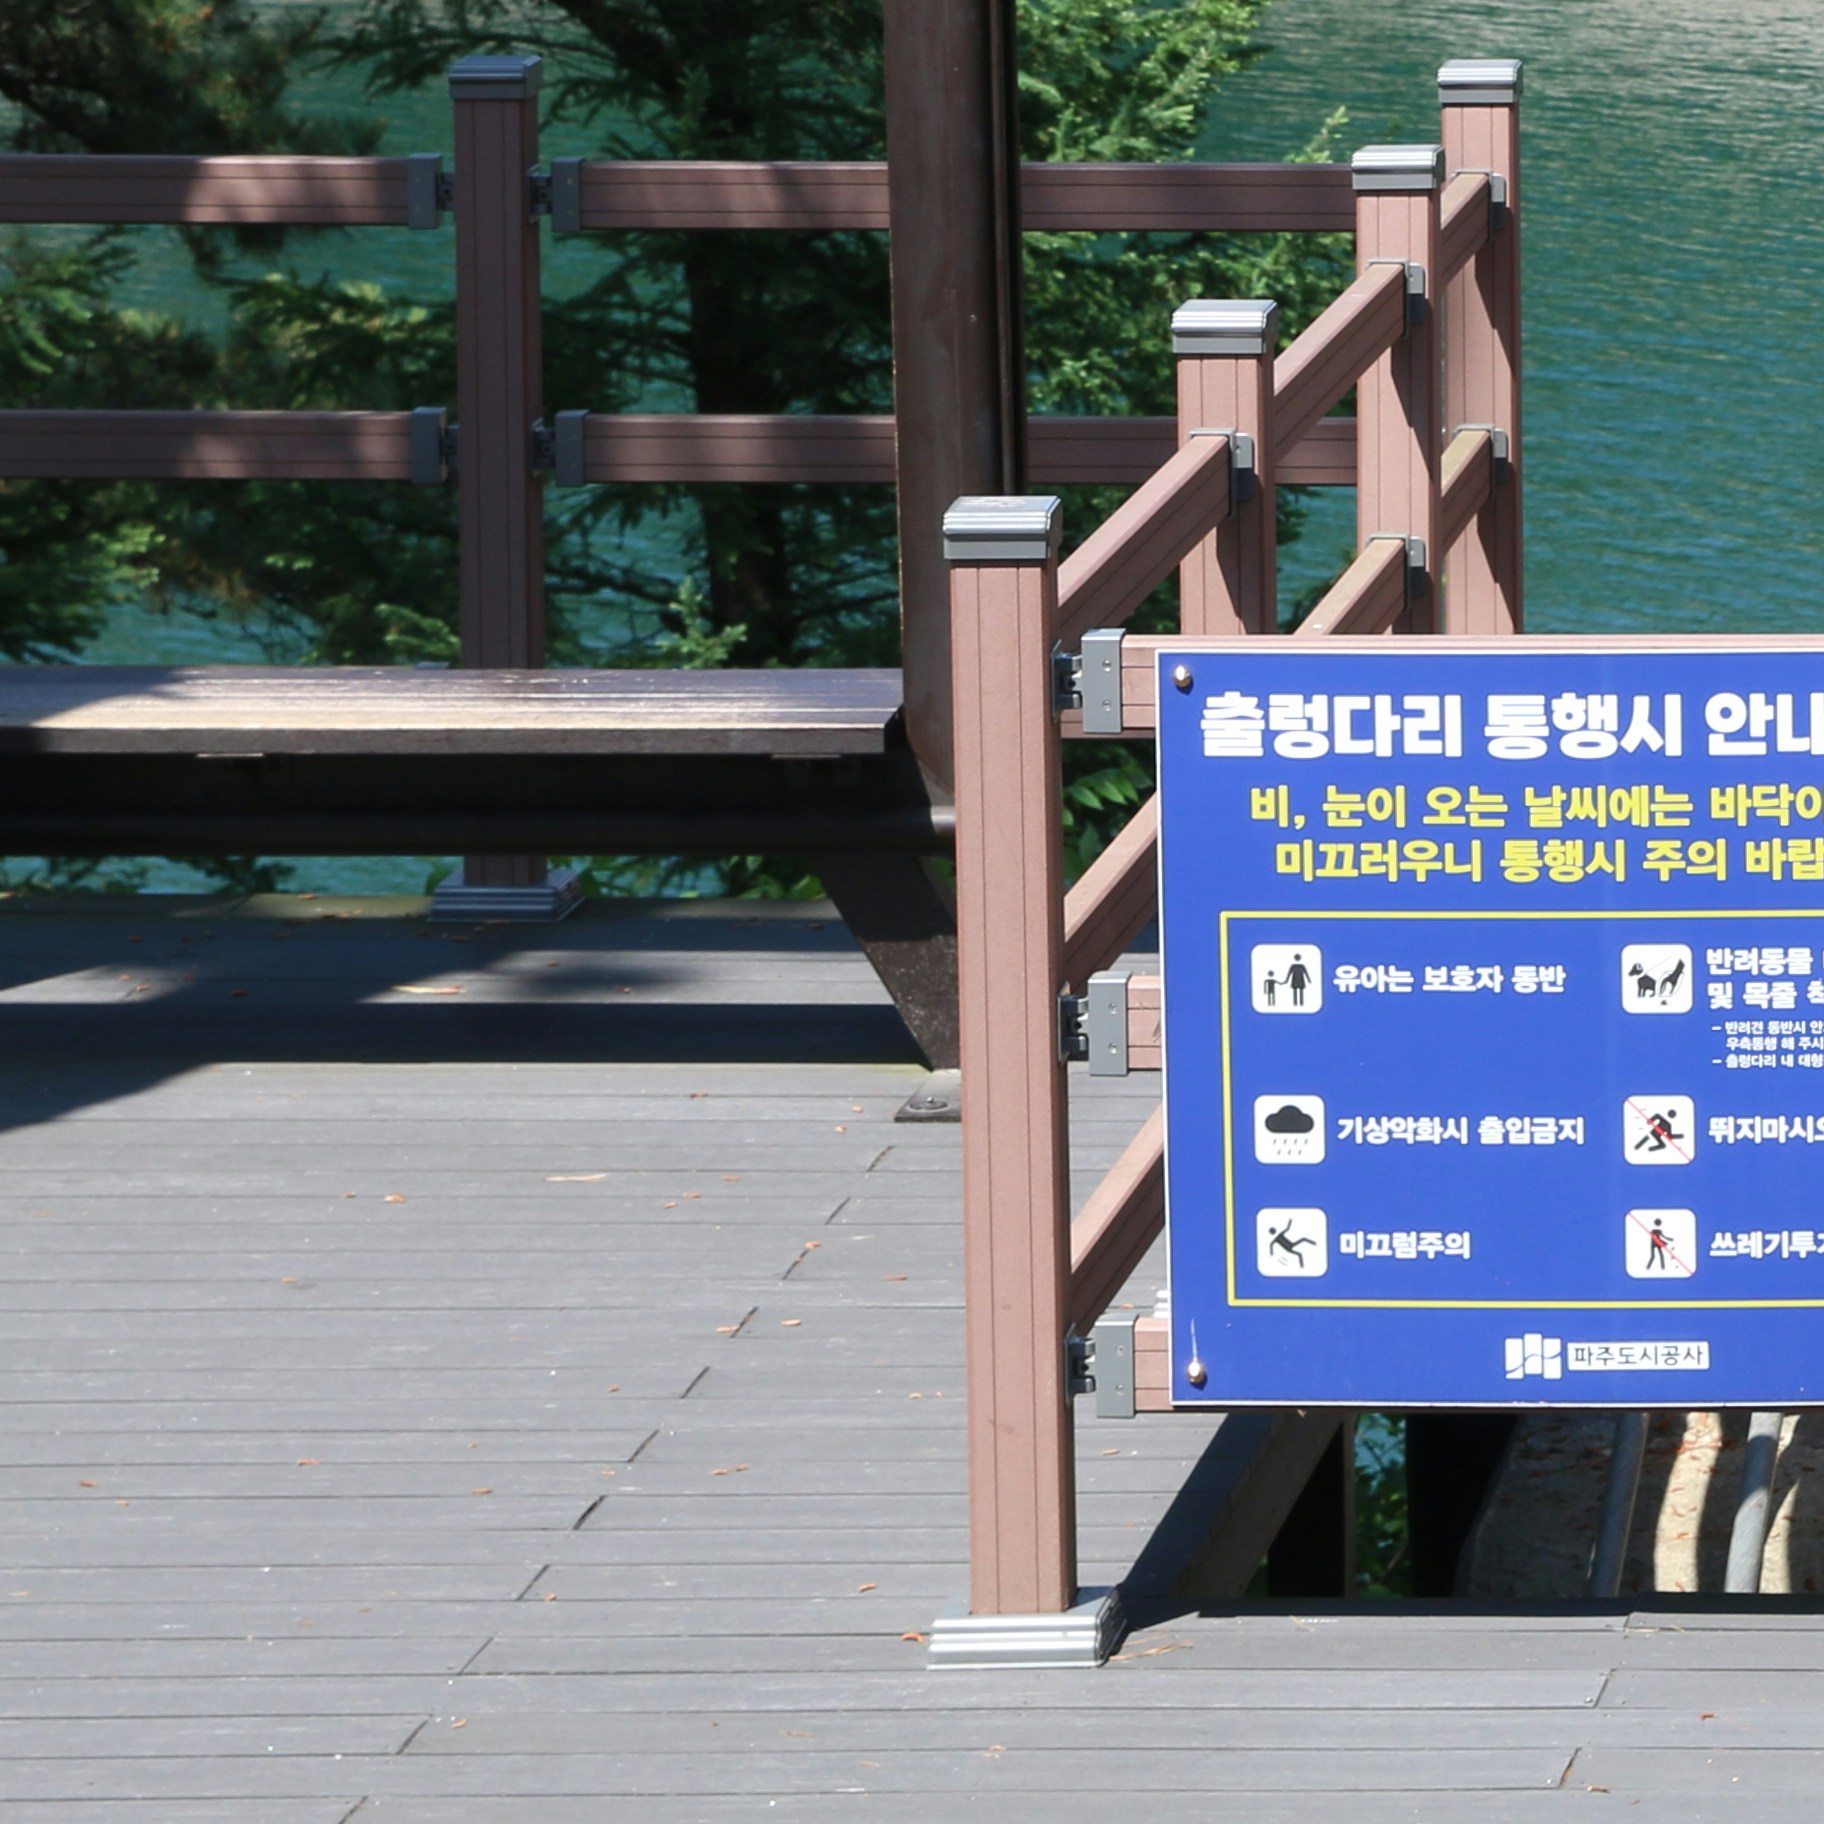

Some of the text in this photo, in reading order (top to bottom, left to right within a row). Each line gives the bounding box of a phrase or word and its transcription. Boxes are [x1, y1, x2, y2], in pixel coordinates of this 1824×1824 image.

[1201, 691, 1462, 758] 출렁다리
[1485, 693, 1682, 759] 통행시
[1251, 785, 1305, 829] 비,
[1323, 785, 1405, 827] 눈이
[1423, 786, 1508, 827] 오는
[1525, 785, 1693, 827] 날씨에는
[1277, 839, 1481, 882] 미끄러우니
[1500, 839, 1625, 882] 통행시
[1643, 839, 1726, 881] 주의
[1707, 948, 1813, 975] 반려동물
[1333, 965, 1566, 993] 유아는 보호자 동반
[1708, 982, 1732, 1009] 및
[1743, 982, 1797, 1009] 목줄
[1725, 1021, 1763, 1034] 반려견
[1768, 1021, 1805, 1034] 동반시
[1727, 1037, 1777, 1050] 우측통행
[1781, 1037, 1794, 1050] 해
[1726, 1054, 1776, 1068] 출렁다리
[1781, 1054, 1793, 1067] 내
[1338, 1117, 1584, 1144] 기상악화시 출입금지
[1340, 1231, 1470, 1259] 미끄럼주의
[1576, 1346, 1701, 1365] 파주도시공사
